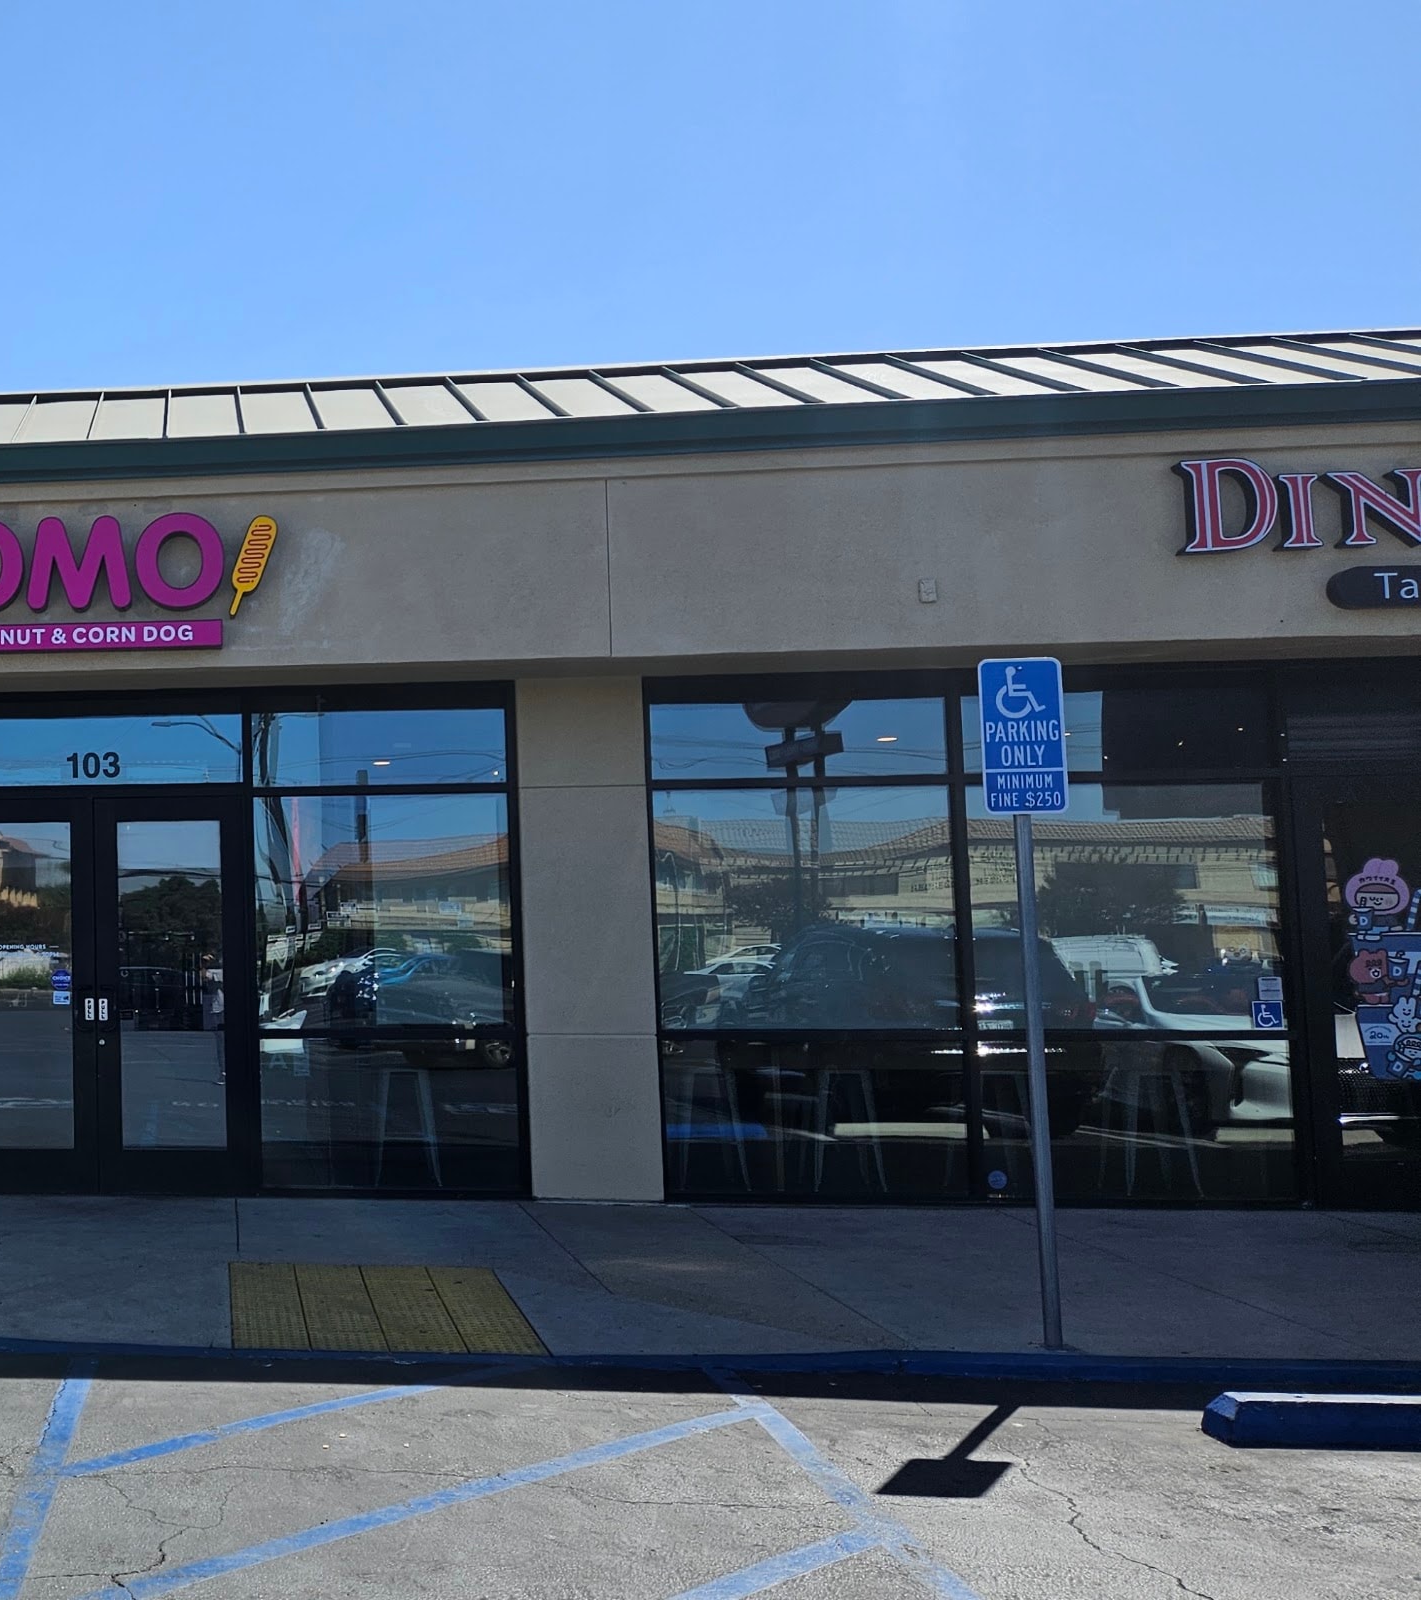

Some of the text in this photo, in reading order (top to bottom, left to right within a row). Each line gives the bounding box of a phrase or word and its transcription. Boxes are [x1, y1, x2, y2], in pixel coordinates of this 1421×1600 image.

[1373, 572, 1420, 600] Ta
[51, 628, 67, 645] &
[72, 626, 136, 644] CORN
[143, 624, 194, 642] DOG
[986, 720, 1059, 743] PARKING
[66, 751, 121, 778] 103
[1001, 744, 1045, 767] ONLY
[997, 774, 1054, 790] MINIMUM
[991, 791, 1061, 808] FINE $250
